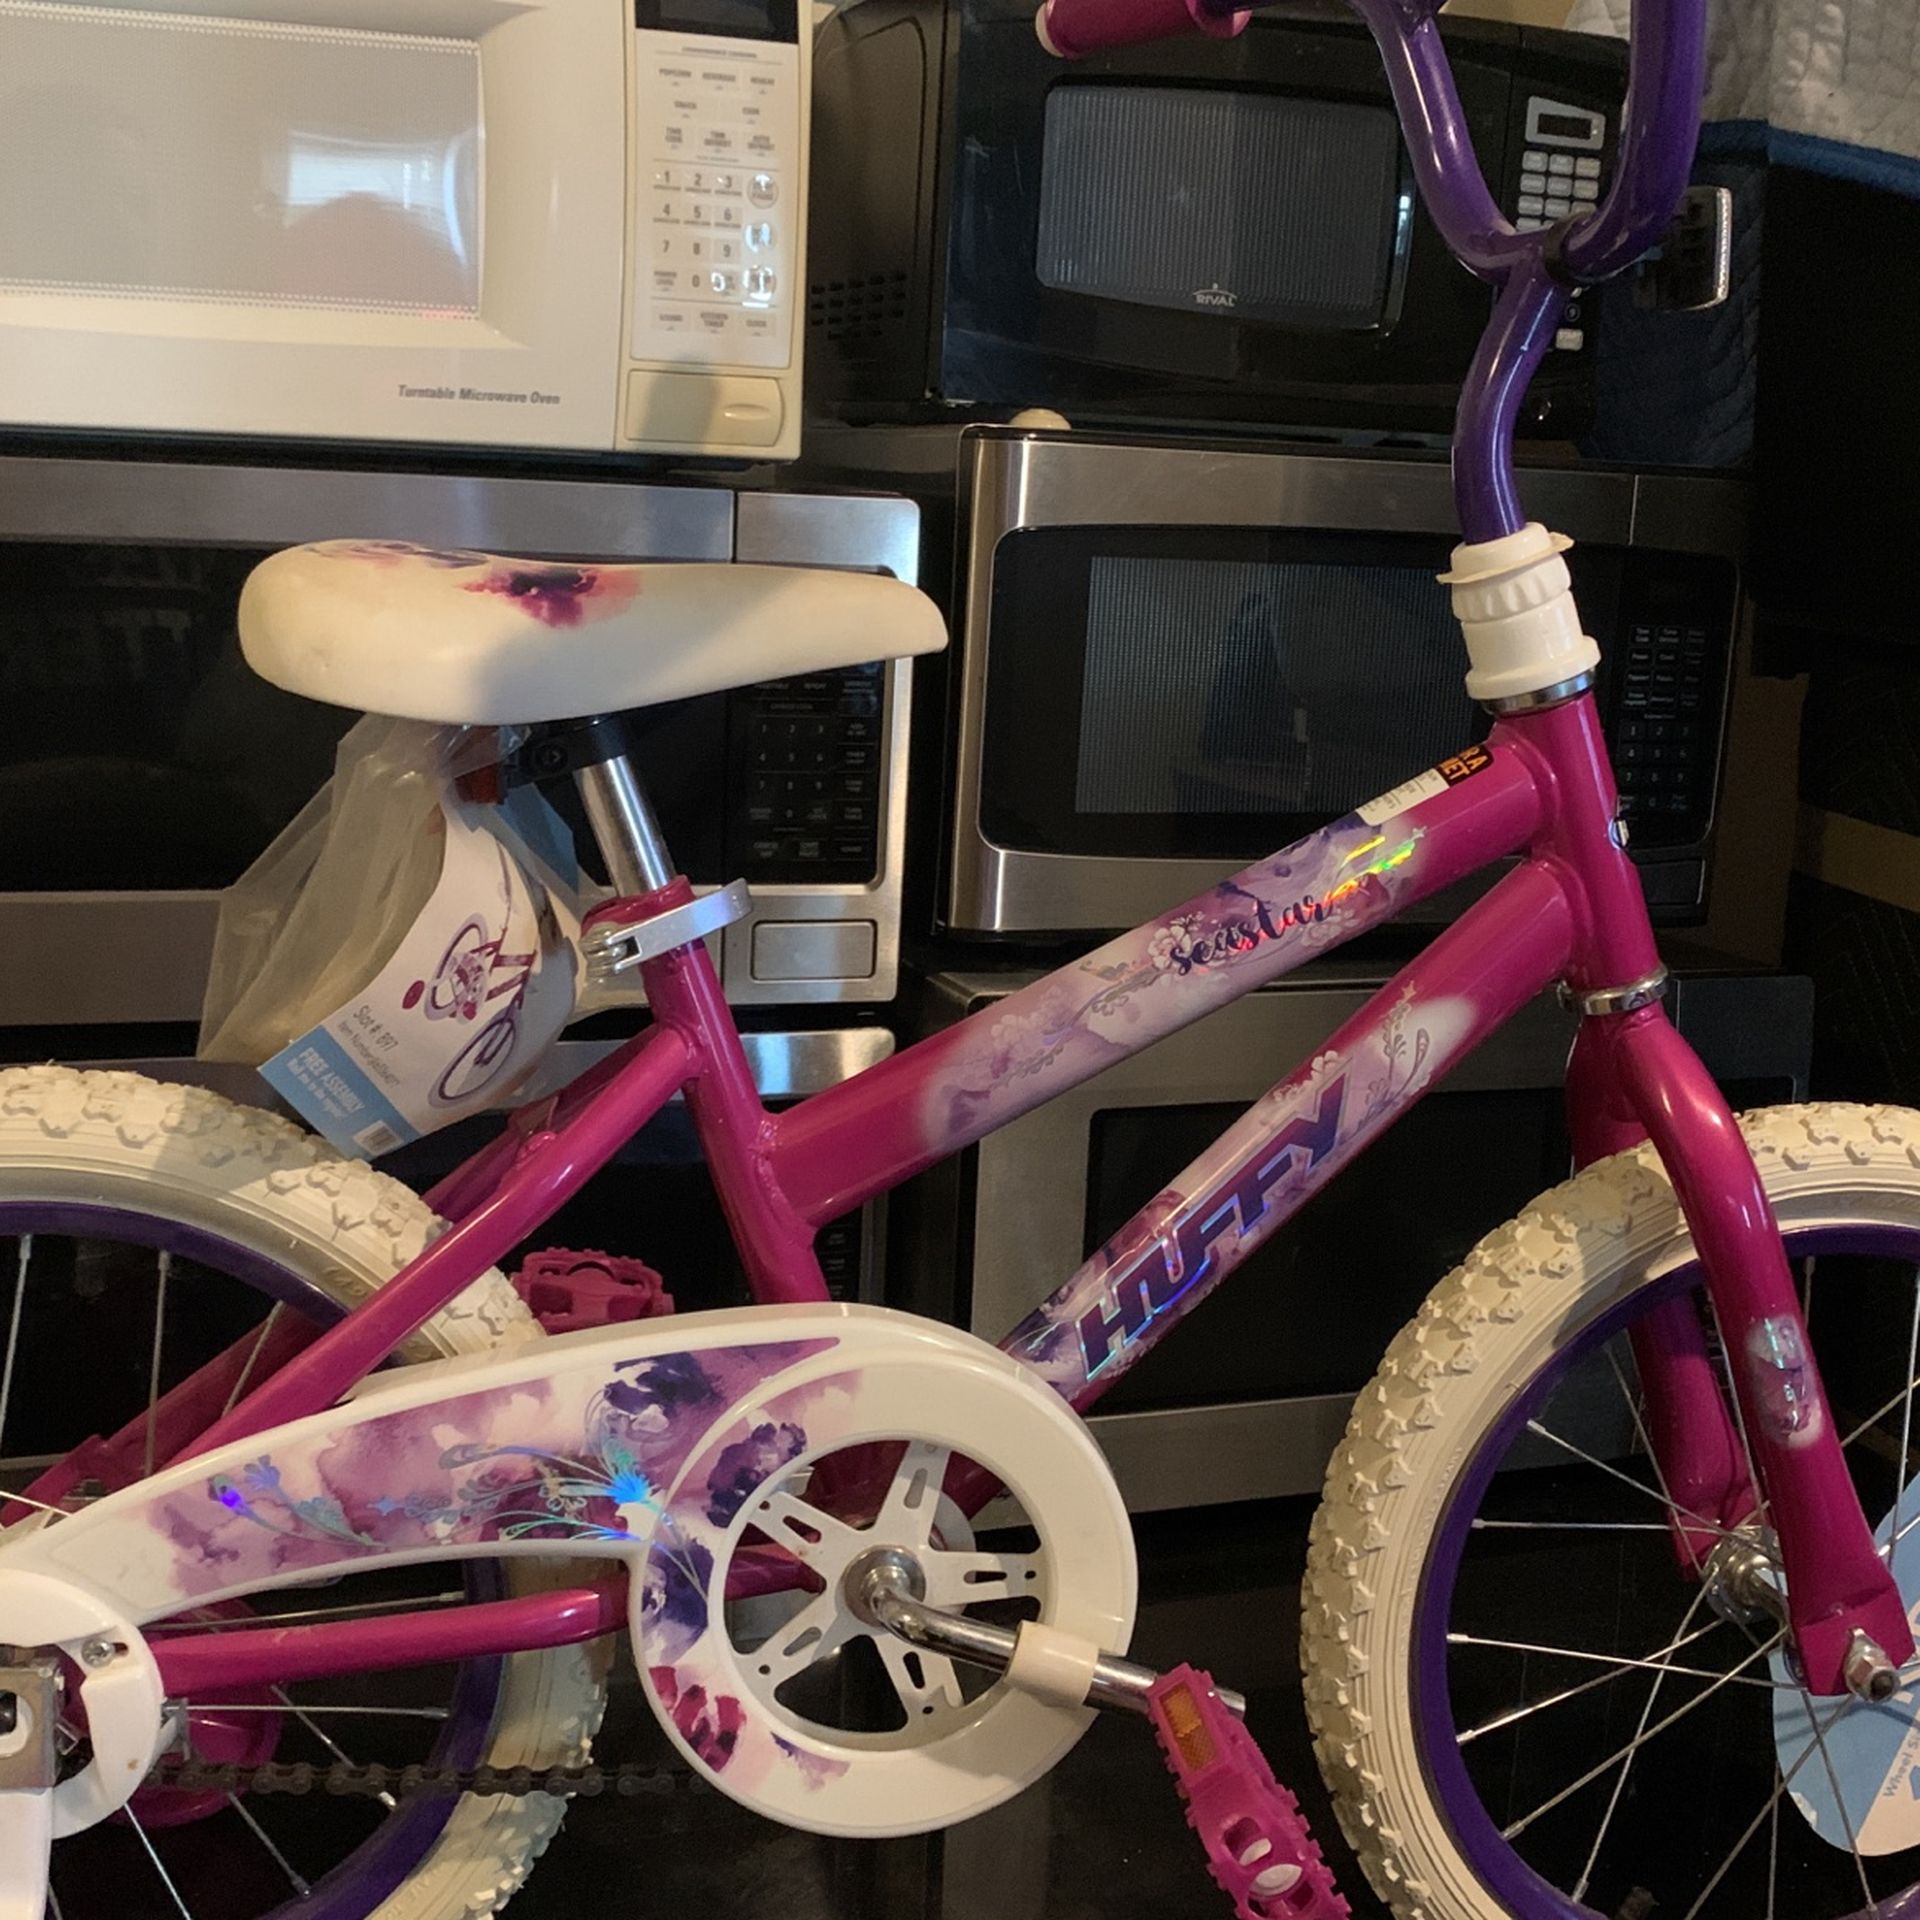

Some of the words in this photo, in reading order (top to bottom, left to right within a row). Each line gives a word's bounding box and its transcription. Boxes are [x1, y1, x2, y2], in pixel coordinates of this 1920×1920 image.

[665, 171, 670, 183] 1
[695, 173, 702, 186] 2
[725, 175, 732, 188] 3
[663, 203, 670, 216] 4
[694, 205, 701, 218] 5
[724, 208, 732, 221] 6
[664, 240, 670, 252] 7
[693, 242, 700, 255] 8
[723, 244, 731, 257] 9
[692, 274, 700, 288] 0
[1195, 294, 1236, 307] RIVAL
[398, 384, 456, 400] Turntable
[459, 388, 528, 403] Microwave
[530, 391, 561, 405] Oven
[1170, 892, 1340, 976] seastar
[353, 1005, 376, 1029] Slot
[299, 1047, 329, 1077] FREE
[1076, 1070, 1349, 1381] HUFFY
[1882, 1752, 1913, 1796] Wheel
